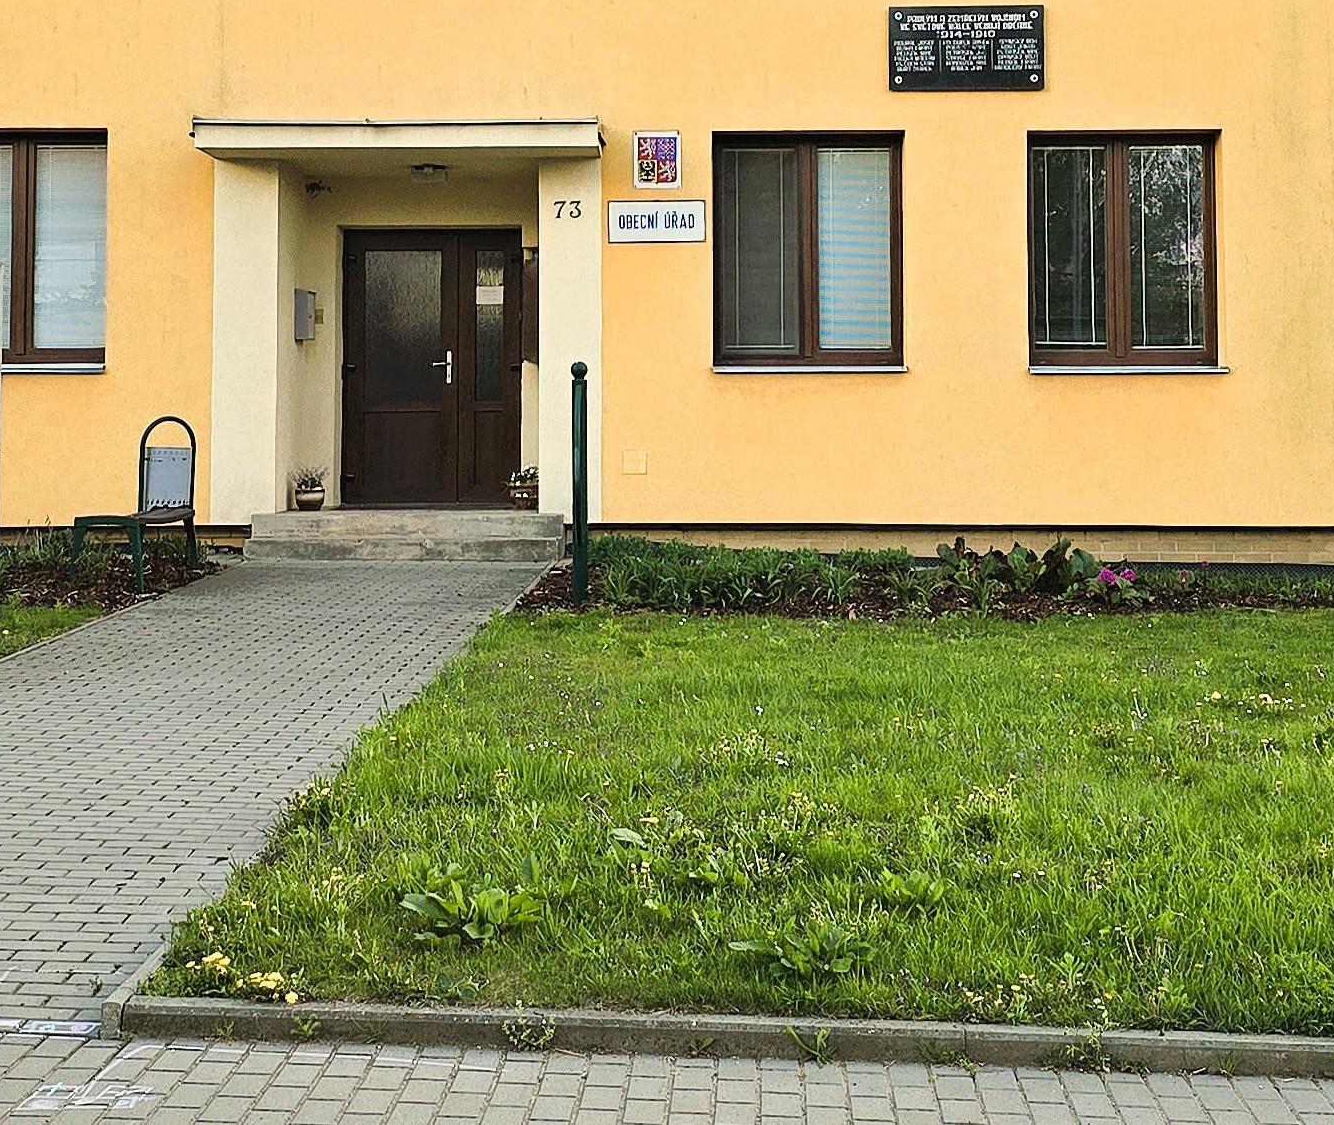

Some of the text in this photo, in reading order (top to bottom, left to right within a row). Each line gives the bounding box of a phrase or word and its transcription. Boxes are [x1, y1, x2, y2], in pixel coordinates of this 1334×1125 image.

[553, 200, 582, 219] 73
[618, 211, 695, 230] OBECNÍ ÚŘAD
